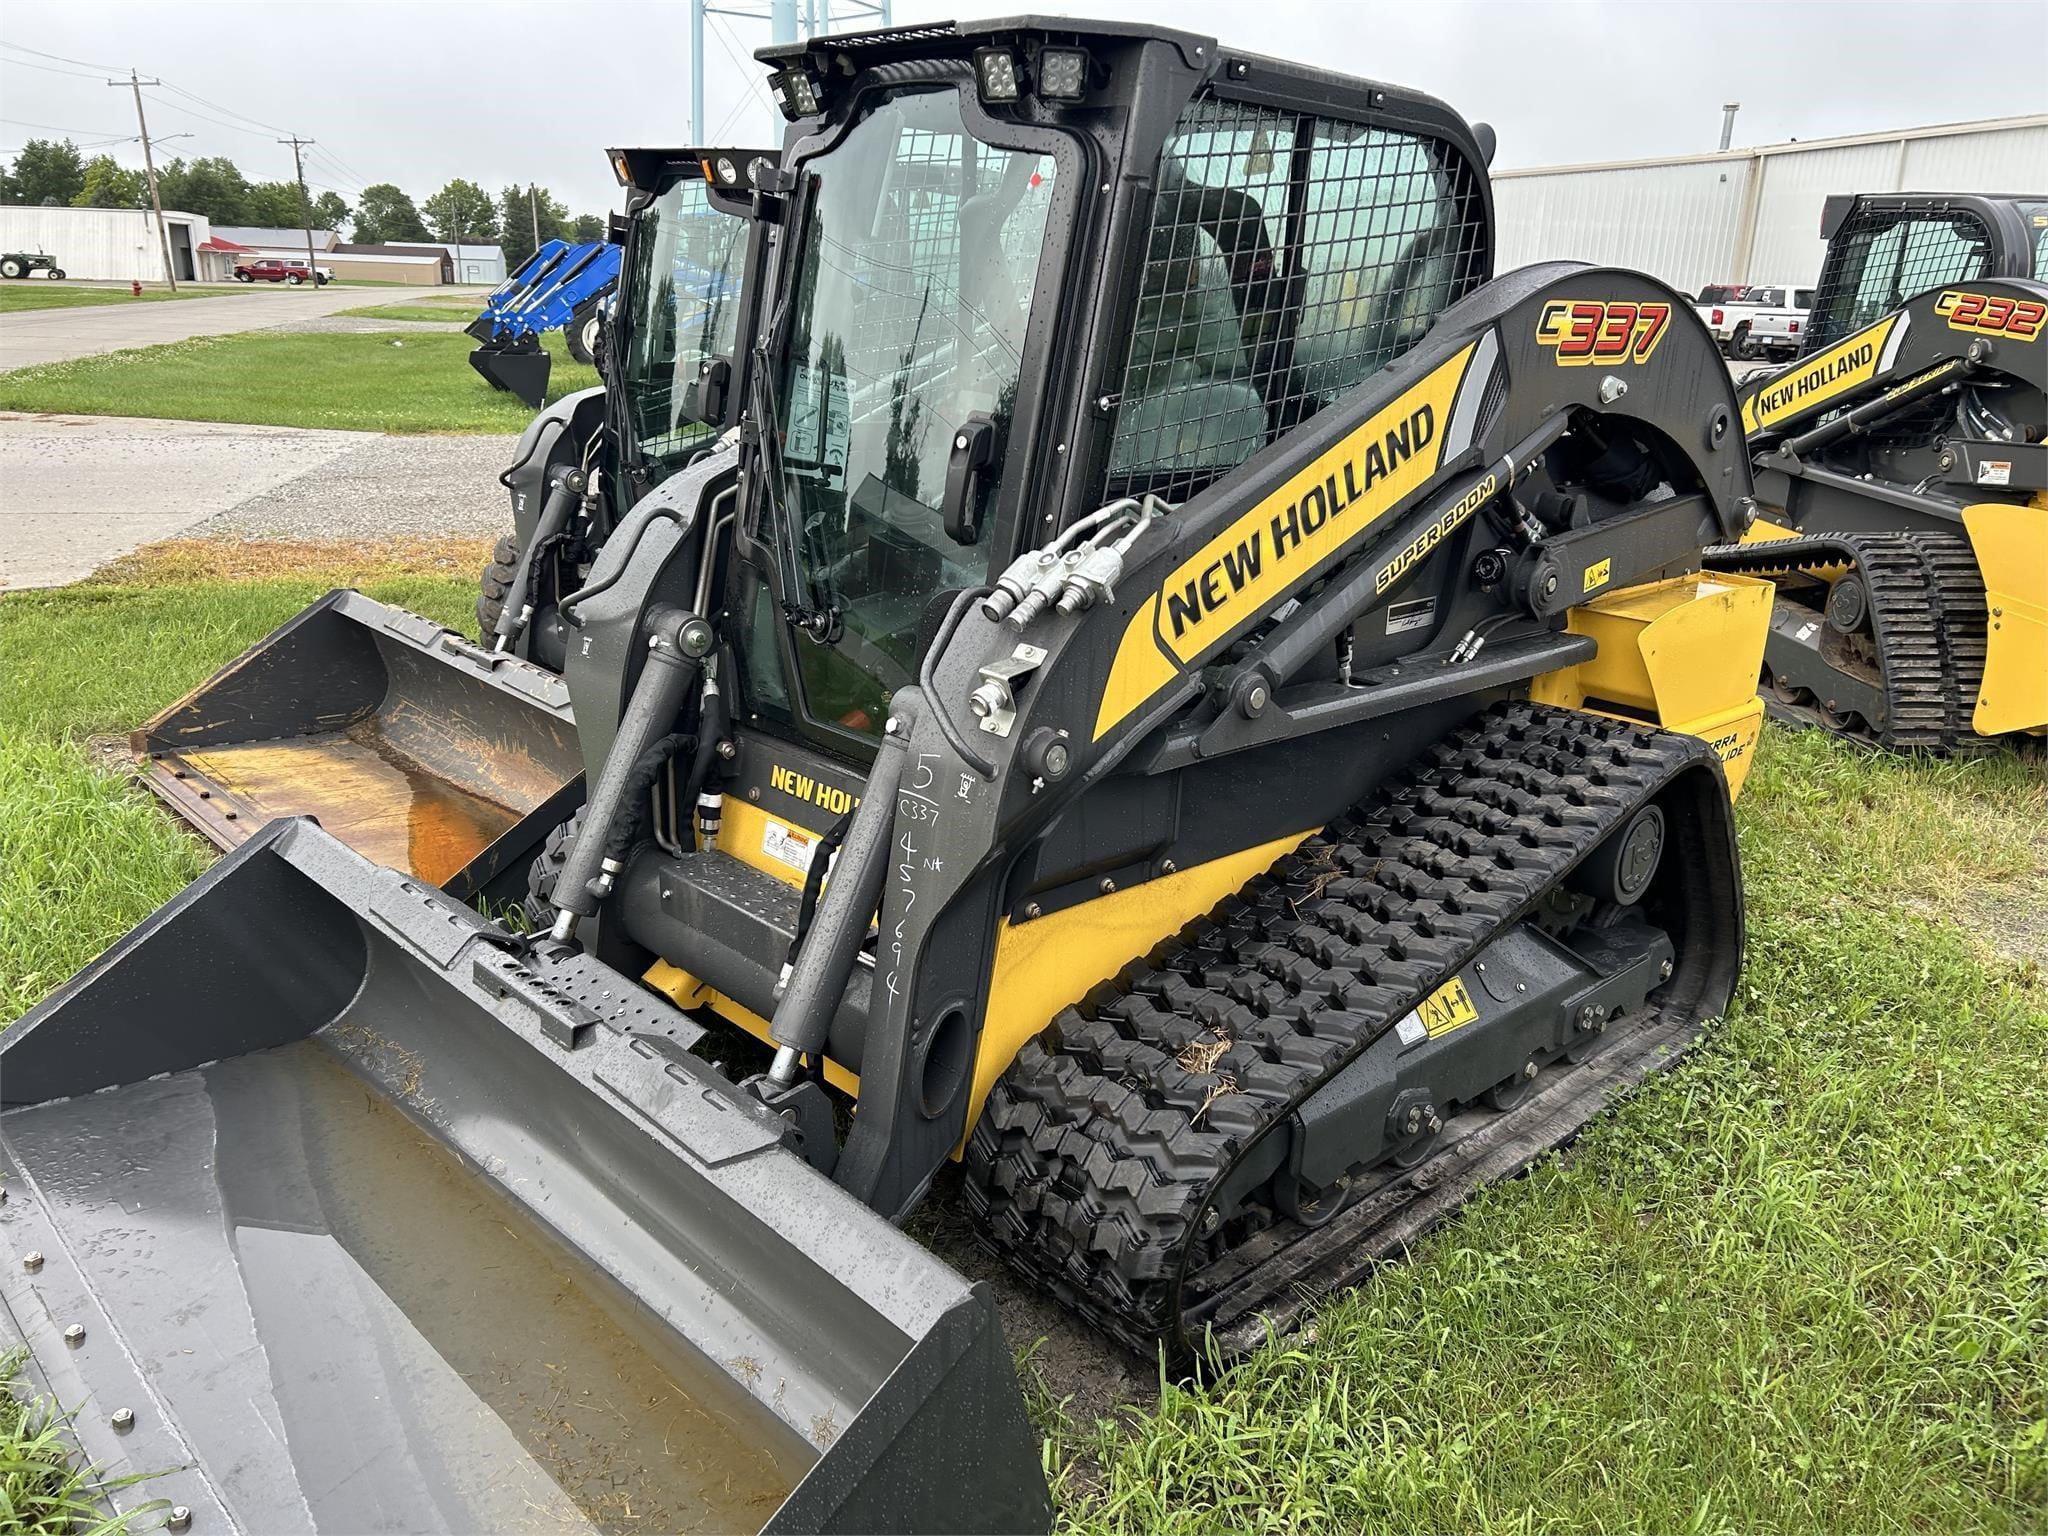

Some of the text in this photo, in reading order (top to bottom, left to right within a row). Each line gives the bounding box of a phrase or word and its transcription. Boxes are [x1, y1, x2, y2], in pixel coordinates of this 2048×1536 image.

[1536, 300, 1671, 366] C337
[1935, 291, 2048, 341] C232
[1761, 343, 1873, 415] NEW HOLLAND
[1167, 403, 1435, 640] NEW HOLLAND
[1376, 474, 1496, 595] SUPER BOOM
[770, 764, 861, 815] NEW HOL
[912, 753, 941, 789] 5
[900, 799, 939, 828] C337
